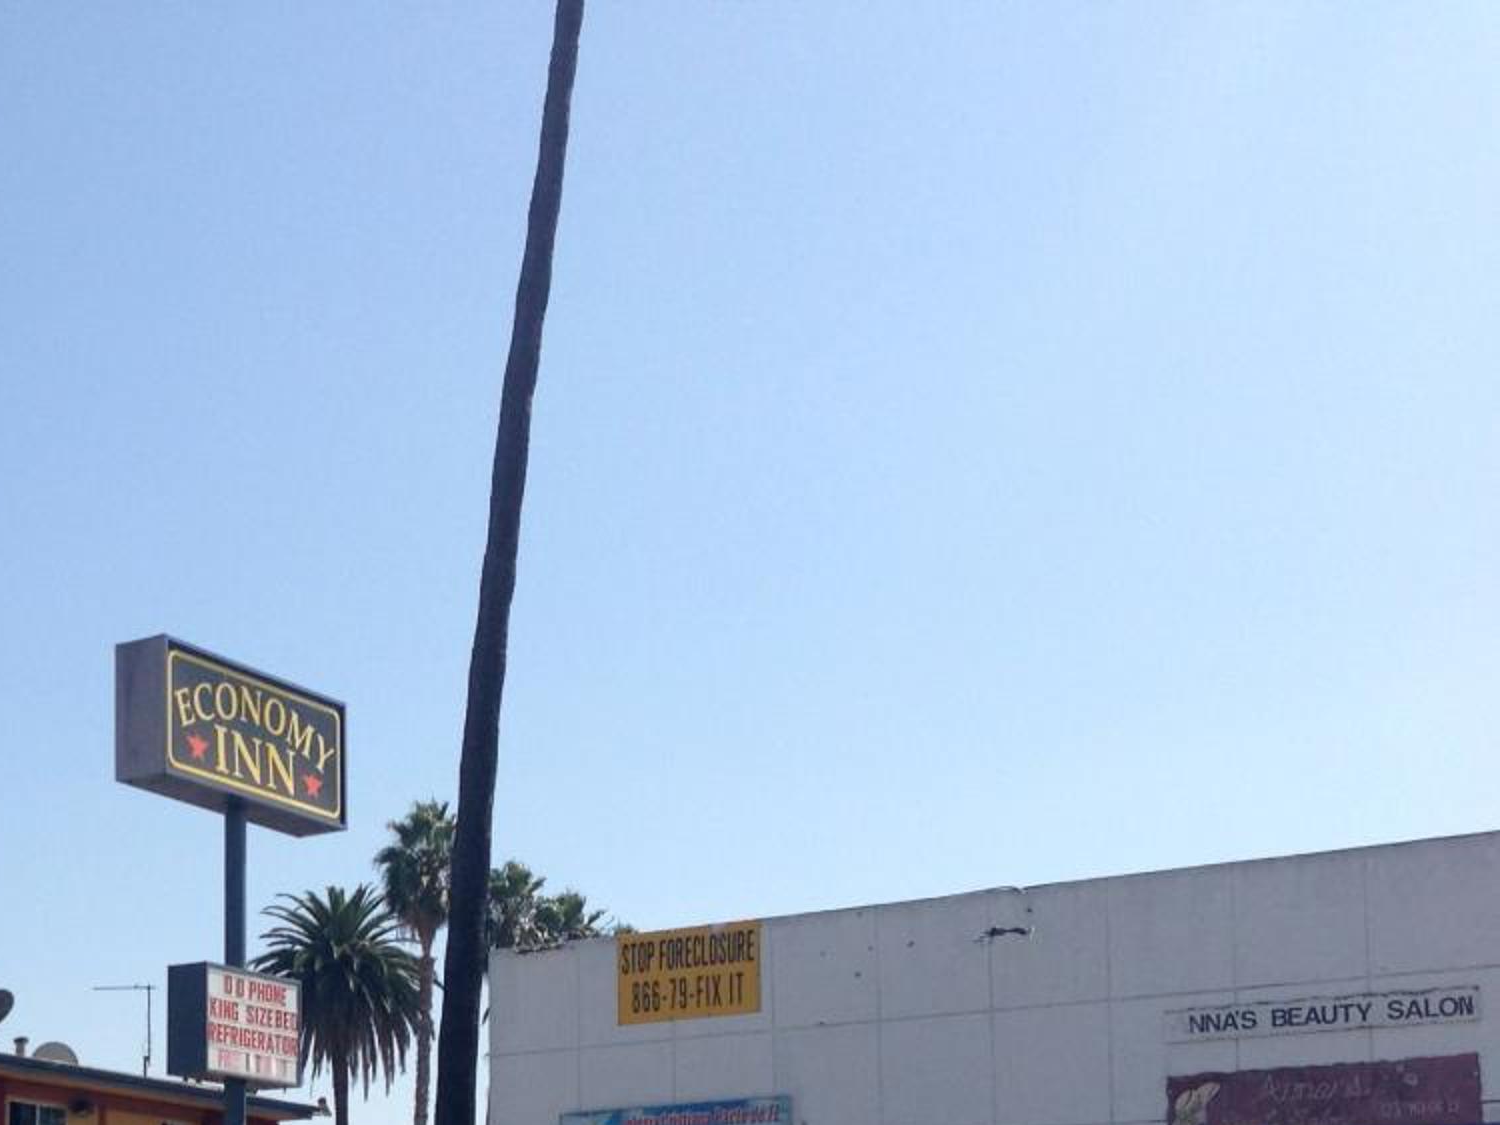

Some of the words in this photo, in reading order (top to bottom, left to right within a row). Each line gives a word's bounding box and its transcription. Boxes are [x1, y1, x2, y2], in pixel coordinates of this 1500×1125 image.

[174, 682, 334, 774] ECONOMY
[214, 724, 296, 797] INN
[621, 942, 655, 975] STOP
[659, 929, 756, 971] FORECLOSURE
[209, 998, 239, 1021] KING
[248, 980, 287, 1007] PHONE
[1271, 1002, 1372, 1028] BEAUTY
[1386, 995, 1475, 1021] SALON
[207, 1022, 299, 1057] REFRIGERATOR
